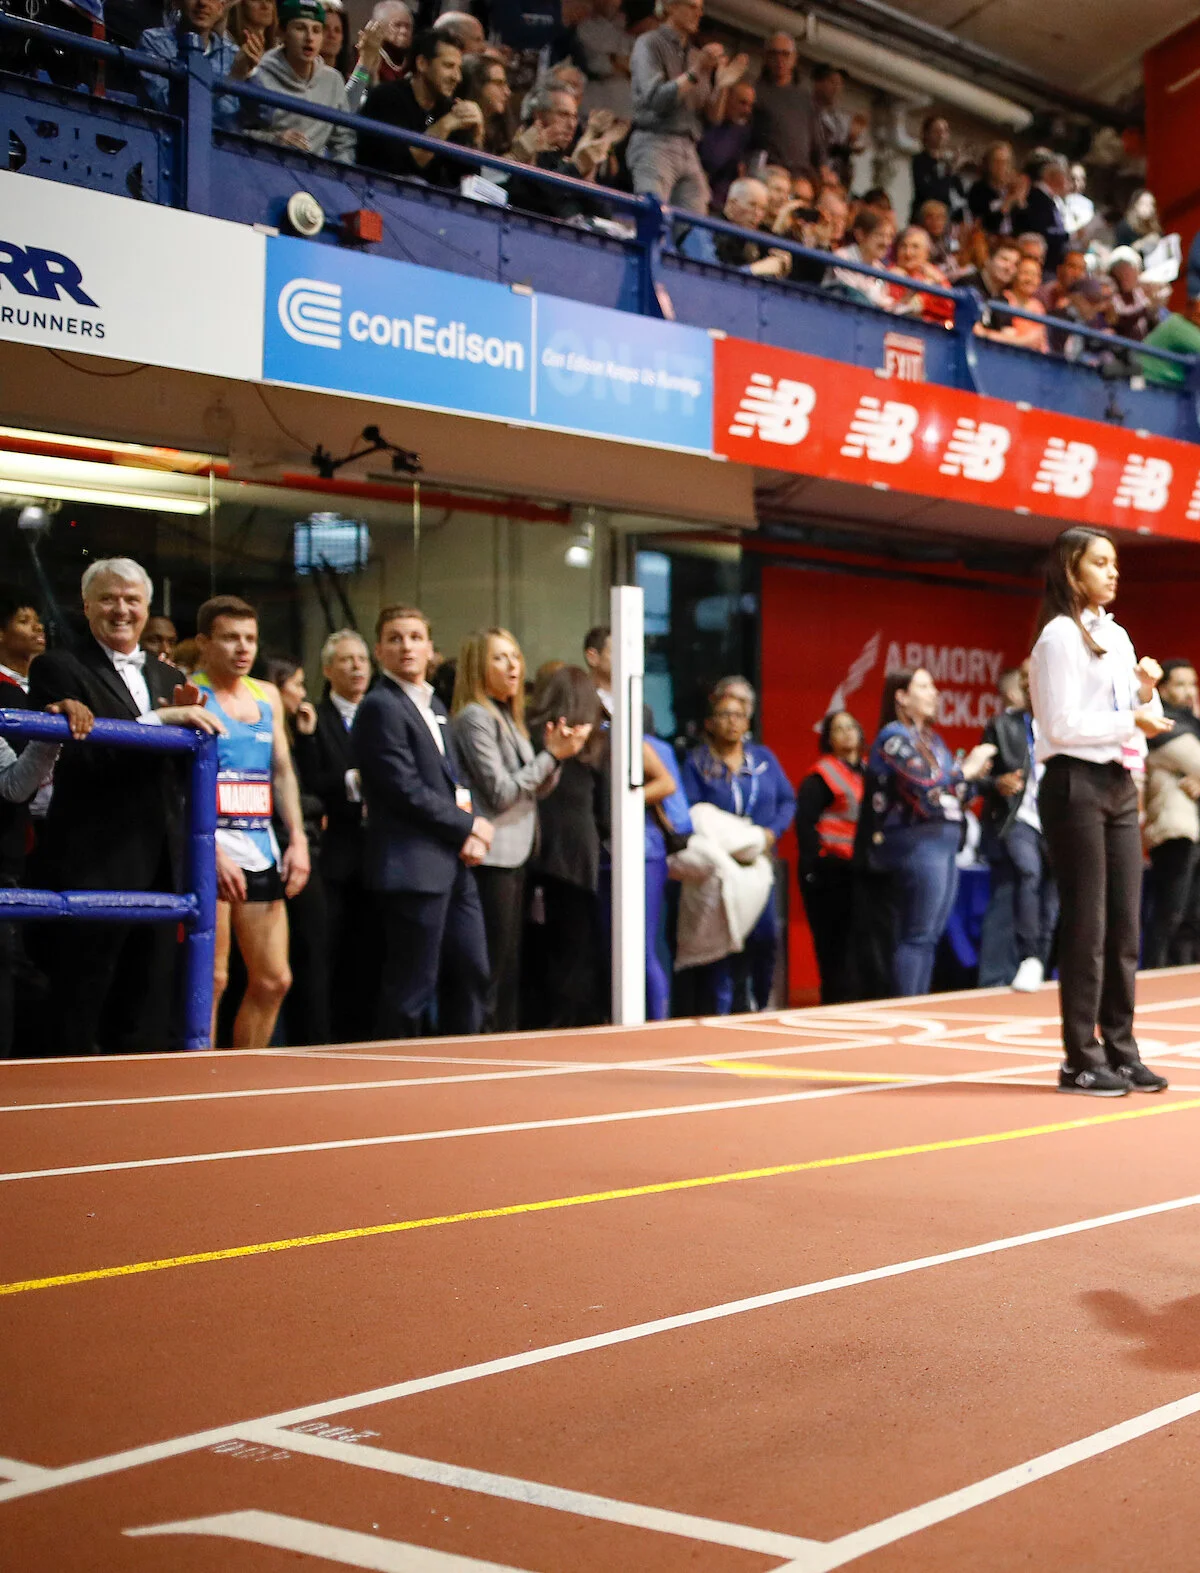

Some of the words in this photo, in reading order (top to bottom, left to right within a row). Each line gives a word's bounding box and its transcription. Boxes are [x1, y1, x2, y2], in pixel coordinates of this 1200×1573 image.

[1, 306, 106, 339] RUNNERS
[348, 310, 525, 371] conEdison
[885, 641, 1004, 685] ARMORY
